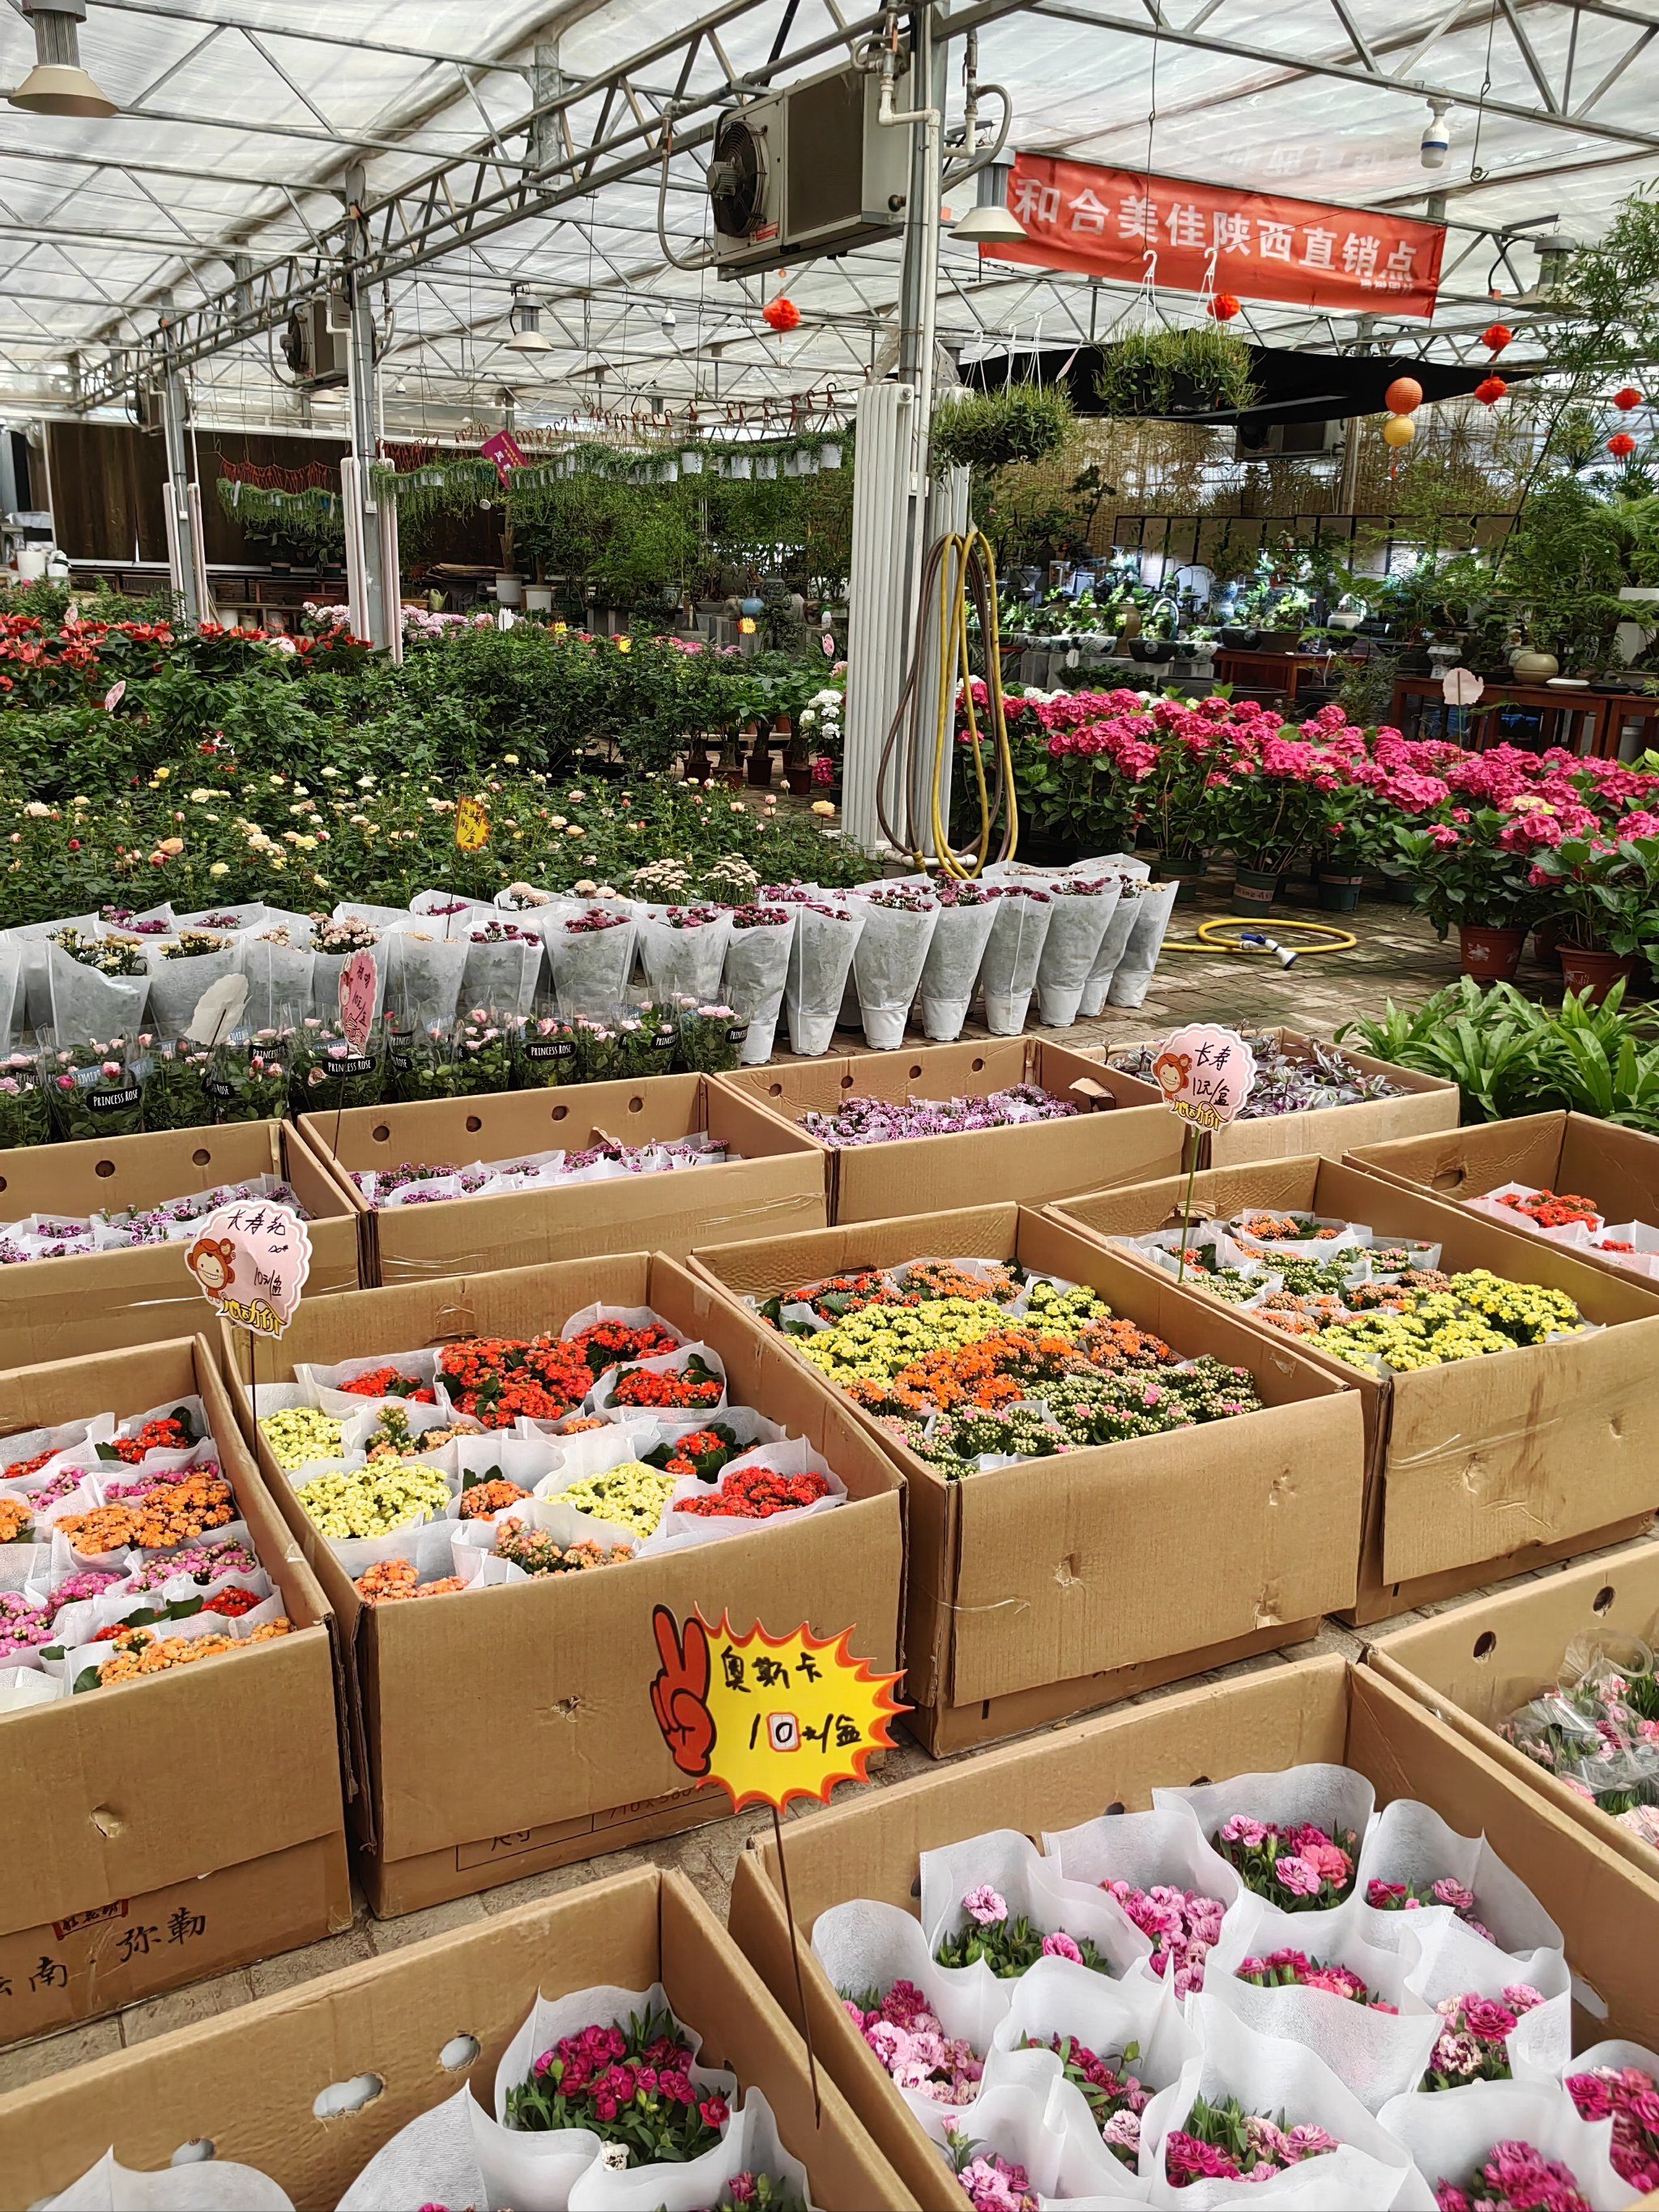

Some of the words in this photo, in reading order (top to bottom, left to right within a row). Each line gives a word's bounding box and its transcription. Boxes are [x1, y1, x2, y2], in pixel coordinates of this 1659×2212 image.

[1013, 177, 1418, 280] 和合美佳陕西直销点
[531, 1046, 558, 1056] PRINCESS
[558, 1044, 572, 1055] ROSE
[1194, 1042, 1231, 1071] 长寿
[93, 1093, 124, 1107] PRINCESS
[125, 1089, 139, 1102] ROSE
[227, 1208, 286, 1236] 长寿花
[720, 1645, 823, 1693] 奥斯卡
